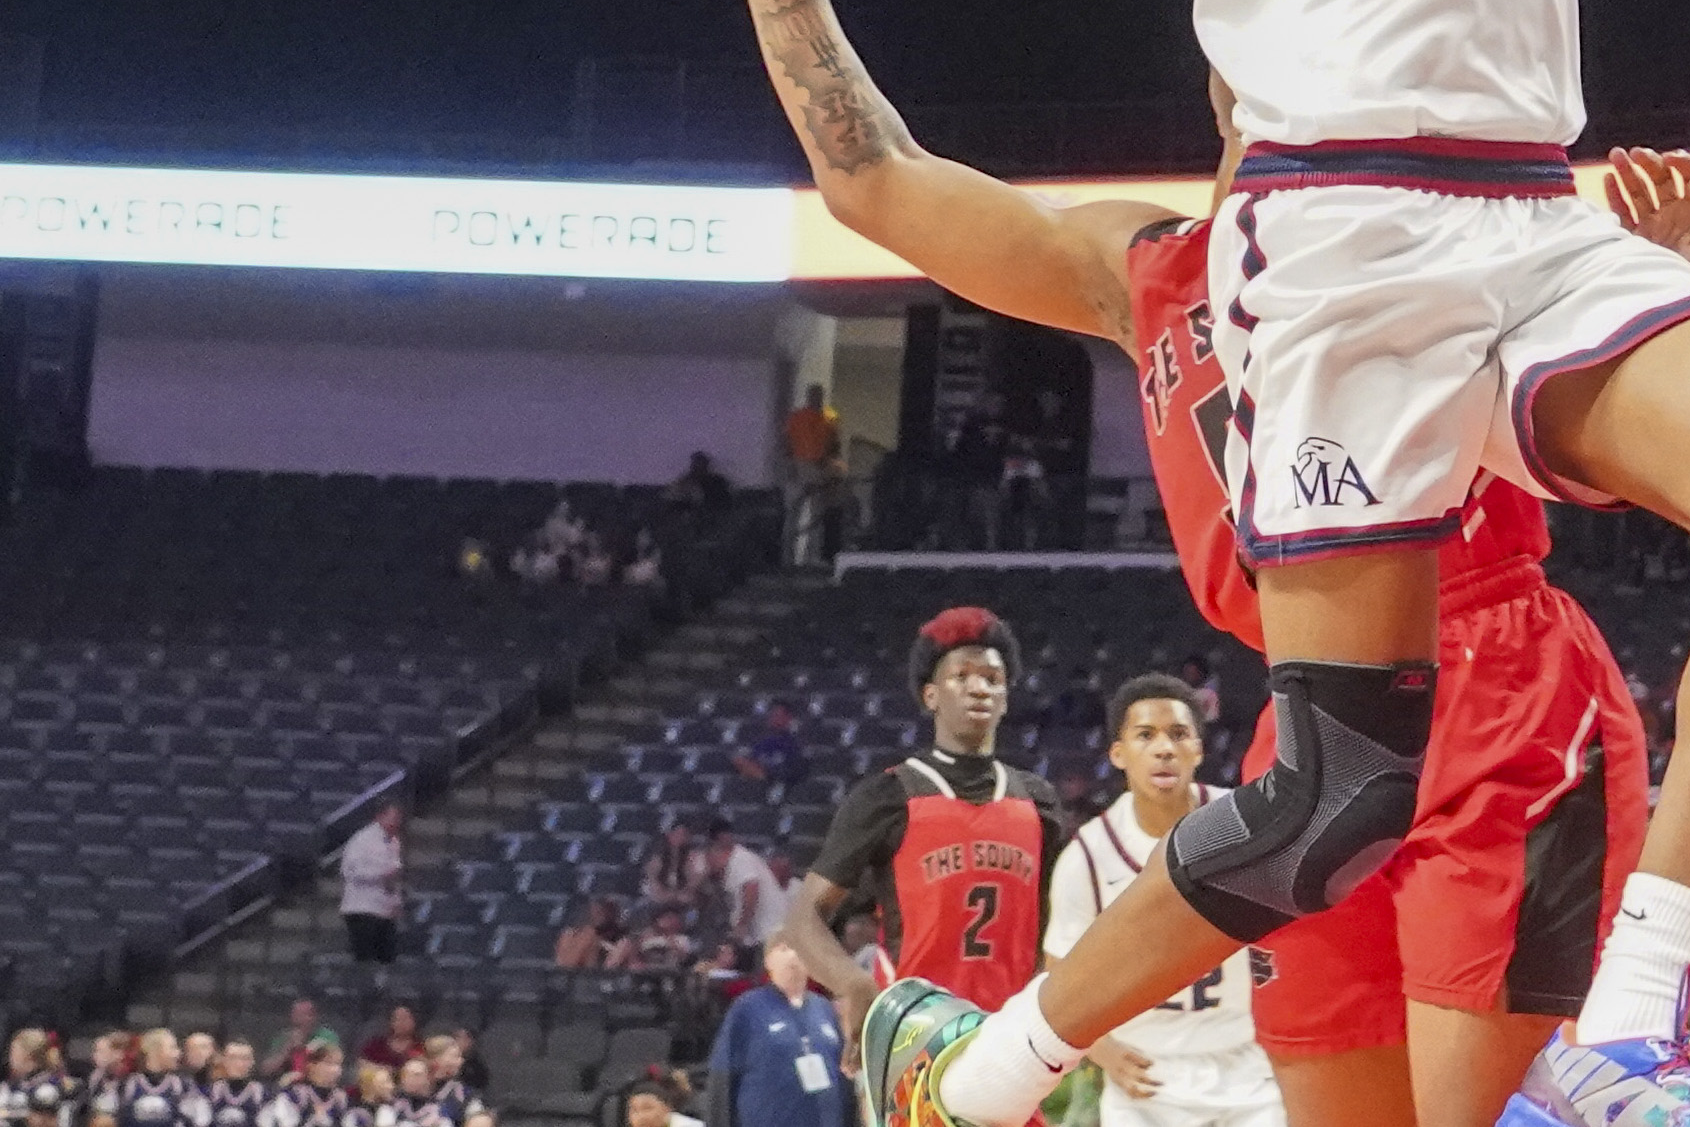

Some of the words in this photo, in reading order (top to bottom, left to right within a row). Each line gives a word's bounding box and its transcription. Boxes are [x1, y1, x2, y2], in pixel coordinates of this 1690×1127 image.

[1, 195, 292, 240] POWERADE
[432, 209, 729, 255] POWERADE
[1289, 455, 1384, 510] MA
[920, 842, 965, 885] THE
[961, 880, 1001, 962] 2
